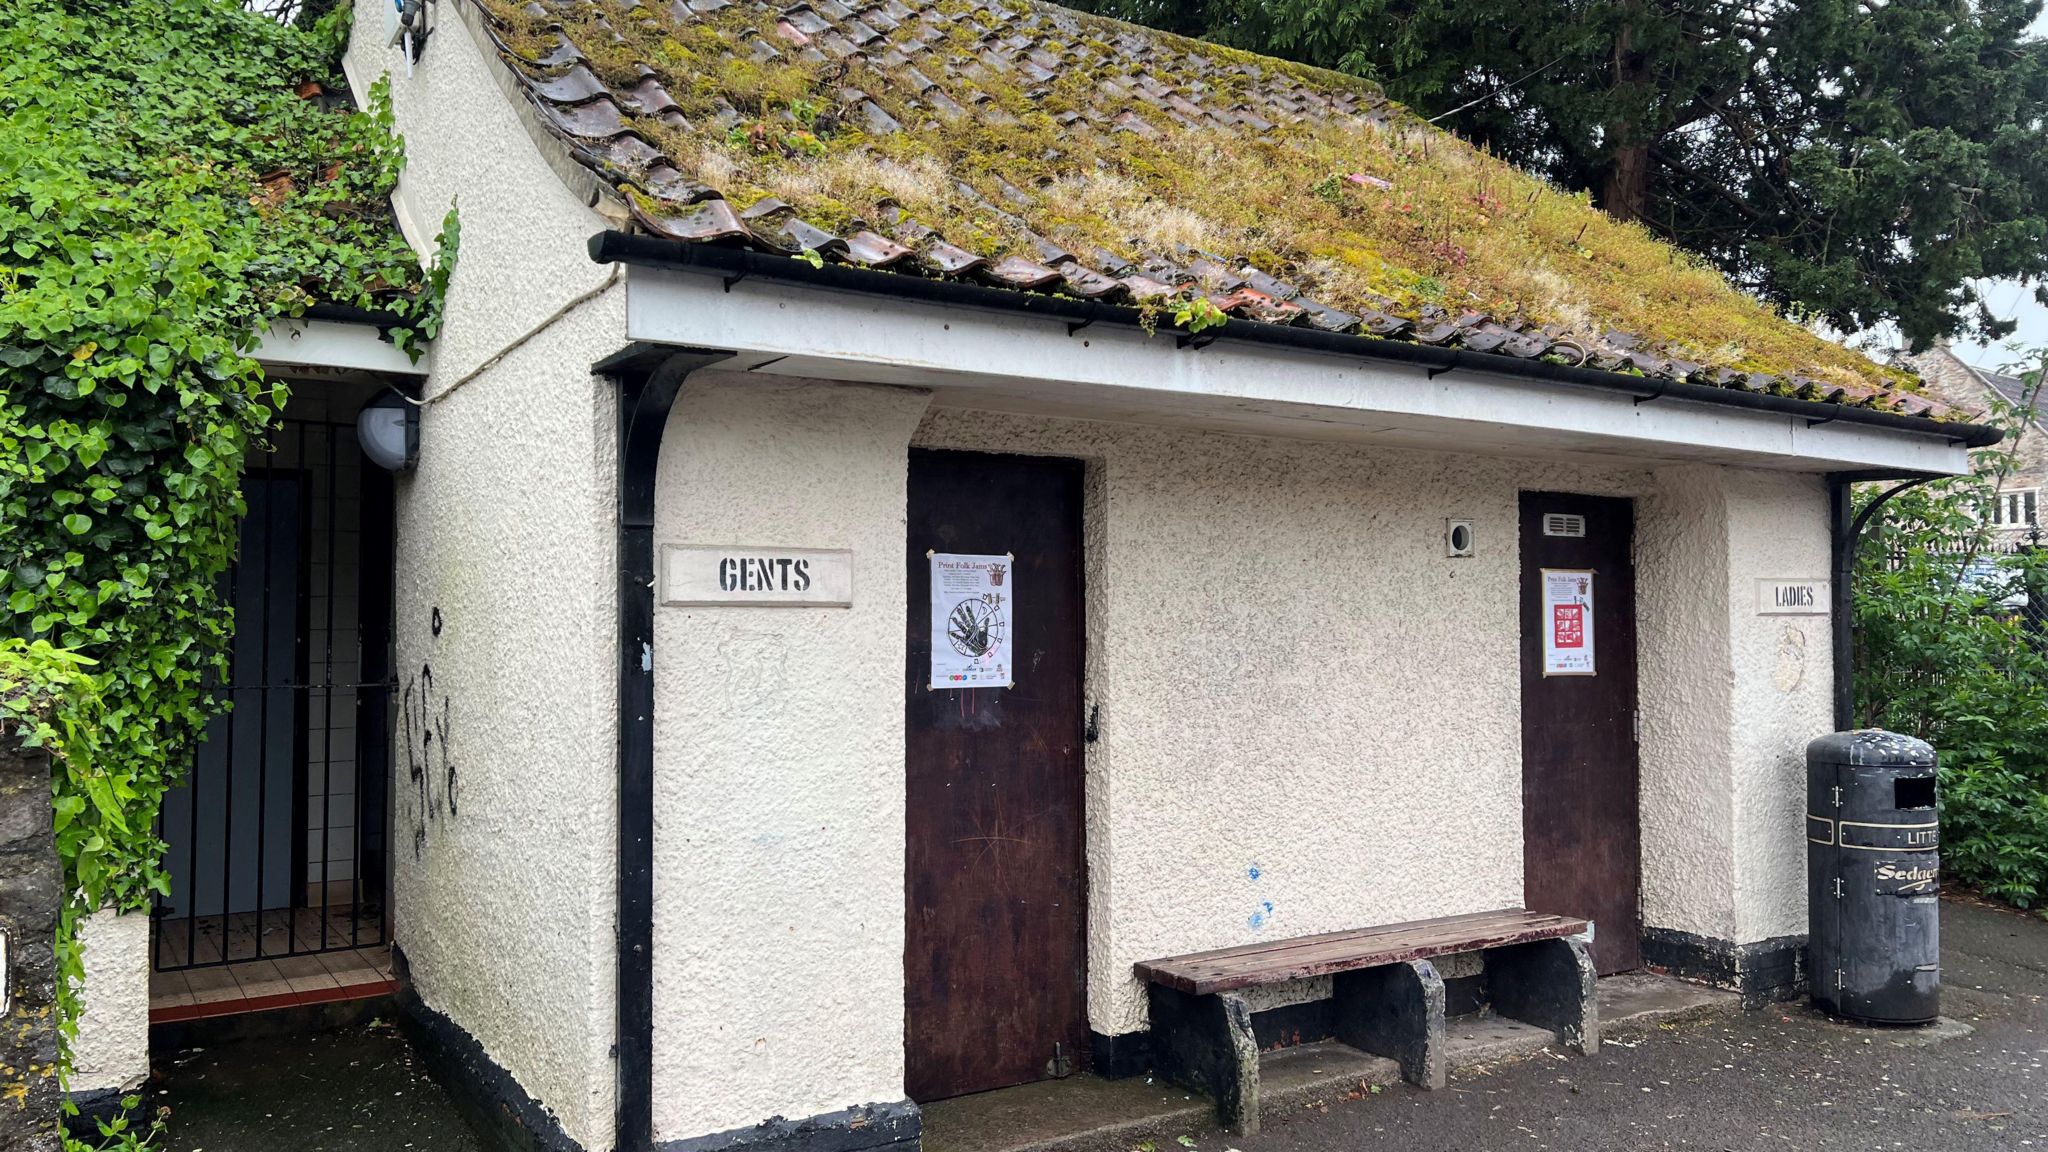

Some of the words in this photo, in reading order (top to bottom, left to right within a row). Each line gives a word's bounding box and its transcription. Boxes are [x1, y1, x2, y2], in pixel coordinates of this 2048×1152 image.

[719, 557, 810, 591] GENTS
[938, 561, 954, 569] Print
[972, 562, 988, 570] Jams
[1775, 586, 1814, 607] LADIES
[1907, 830, 1939, 845] LITTE
